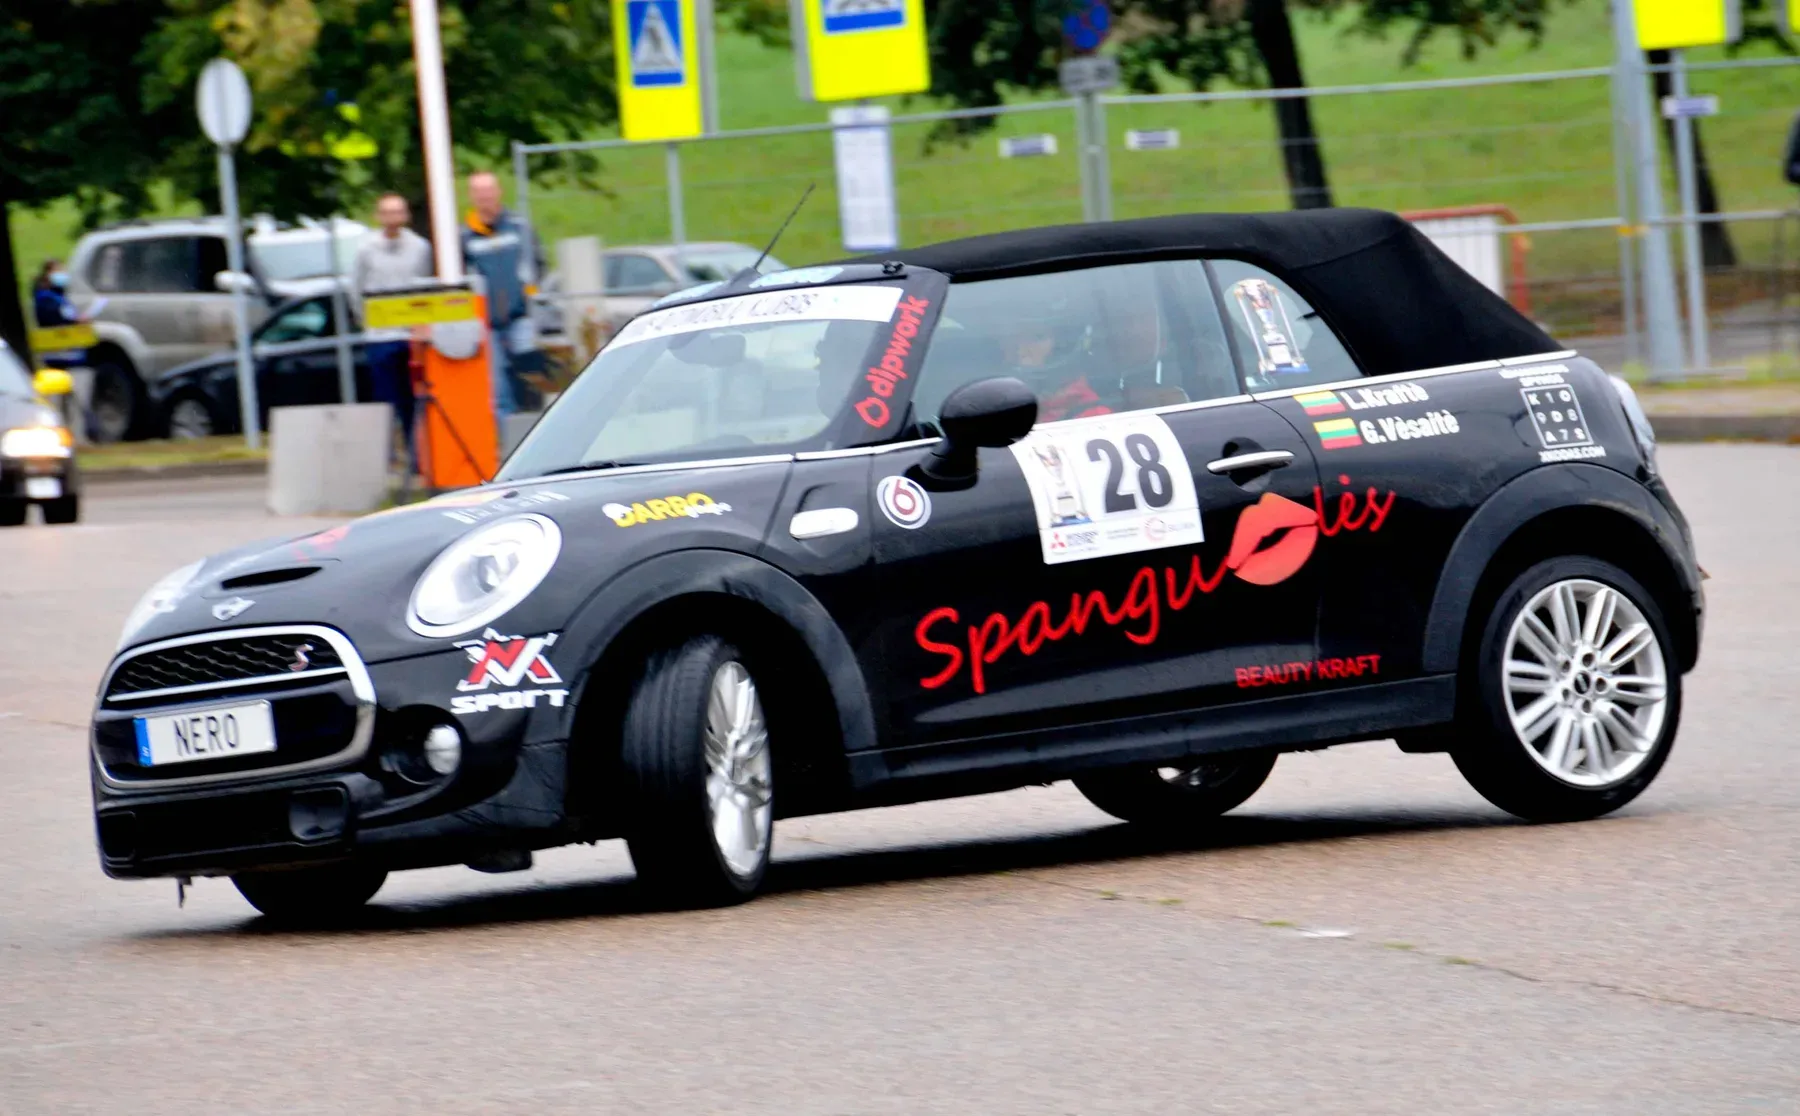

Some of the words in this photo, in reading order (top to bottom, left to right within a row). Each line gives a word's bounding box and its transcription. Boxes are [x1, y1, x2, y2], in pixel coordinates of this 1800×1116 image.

[1085, 433, 1173, 513] 28
[1234, 660, 1313, 688] BEAUTY
[1315, 654, 1381, 679] KRAFT
[450, 689, 570, 714] SPORT
[173, 712, 240, 757] NERO
